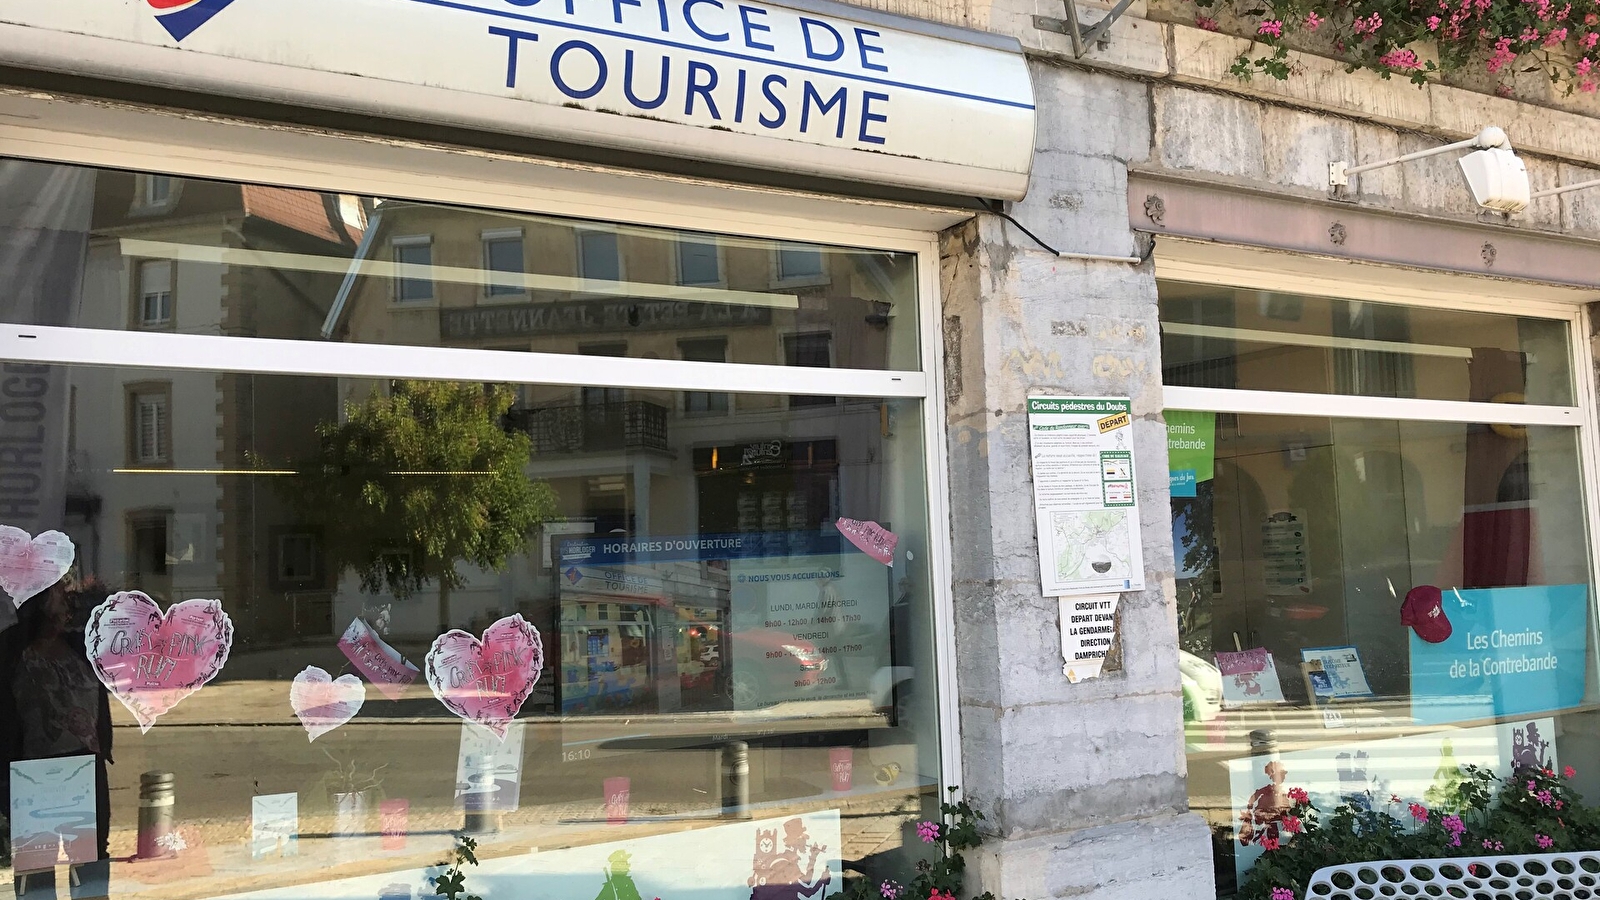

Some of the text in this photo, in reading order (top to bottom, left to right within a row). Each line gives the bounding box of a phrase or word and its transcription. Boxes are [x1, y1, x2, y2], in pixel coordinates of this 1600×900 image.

[799, 16, 888, 72] DE
[488, 26, 889, 144] TOURISME
[1031, 400, 1127, 412] Circuits pédestres du Doubs
[603, 538, 742, 554] HORAIRES D'OUVERTURE
[748, 574, 770, 582] NOUS
[770, 573, 791, 581] VOUS
[605, 581, 648, 594] TOURISME
[821, 600, 858, 609] MERCREDI
[1075, 601, 1111, 611] CIRCUIT VTT
[764, 619, 782, 628] 9h00
[788, 618, 808, 626] 12h00
[817, 616, 836, 625] 14h00
[1071, 614, 1093, 623] DEPART
[792, 631, 829, 641] VENDREDI
[1070, 627, 1078, 636] LA
[1080, 638, 1111, 647] DIRECTION
[1467, 627, 1543, 651] Les Chemins
[765, 651, 783, 659] 9h00
[818, 646, 837, 655] 14h00
[843, 644, 862, 652] 17h00
[1450, 652, 1558, 679] de la Contrebande
[793, 679, 811, 688] 9h00
[817, 676, 836, 685] 12h00
[562, 749, 591, 762] 16:10
